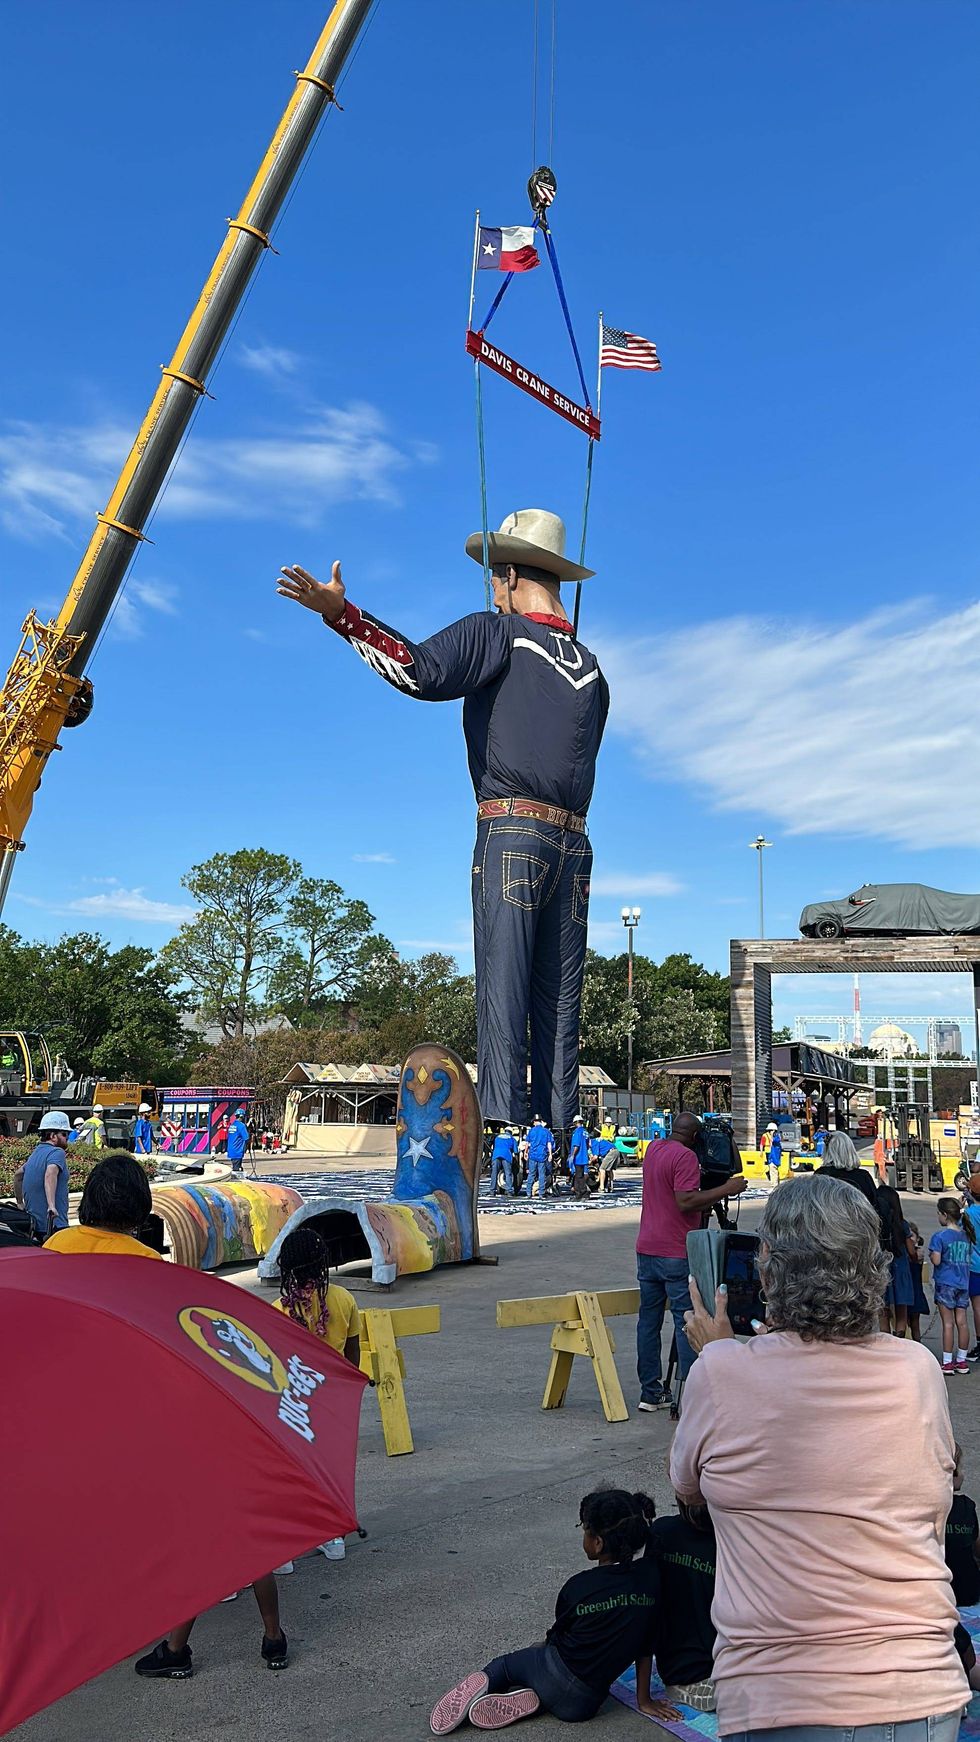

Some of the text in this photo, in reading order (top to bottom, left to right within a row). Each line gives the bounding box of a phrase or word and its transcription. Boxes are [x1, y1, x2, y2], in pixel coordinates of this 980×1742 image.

[481, 341, 590, 427] DAVIS CRANE SERVICE
[546, 807, 569, 826] BIG
[576, 1593, 628, 1616] Greenhill
